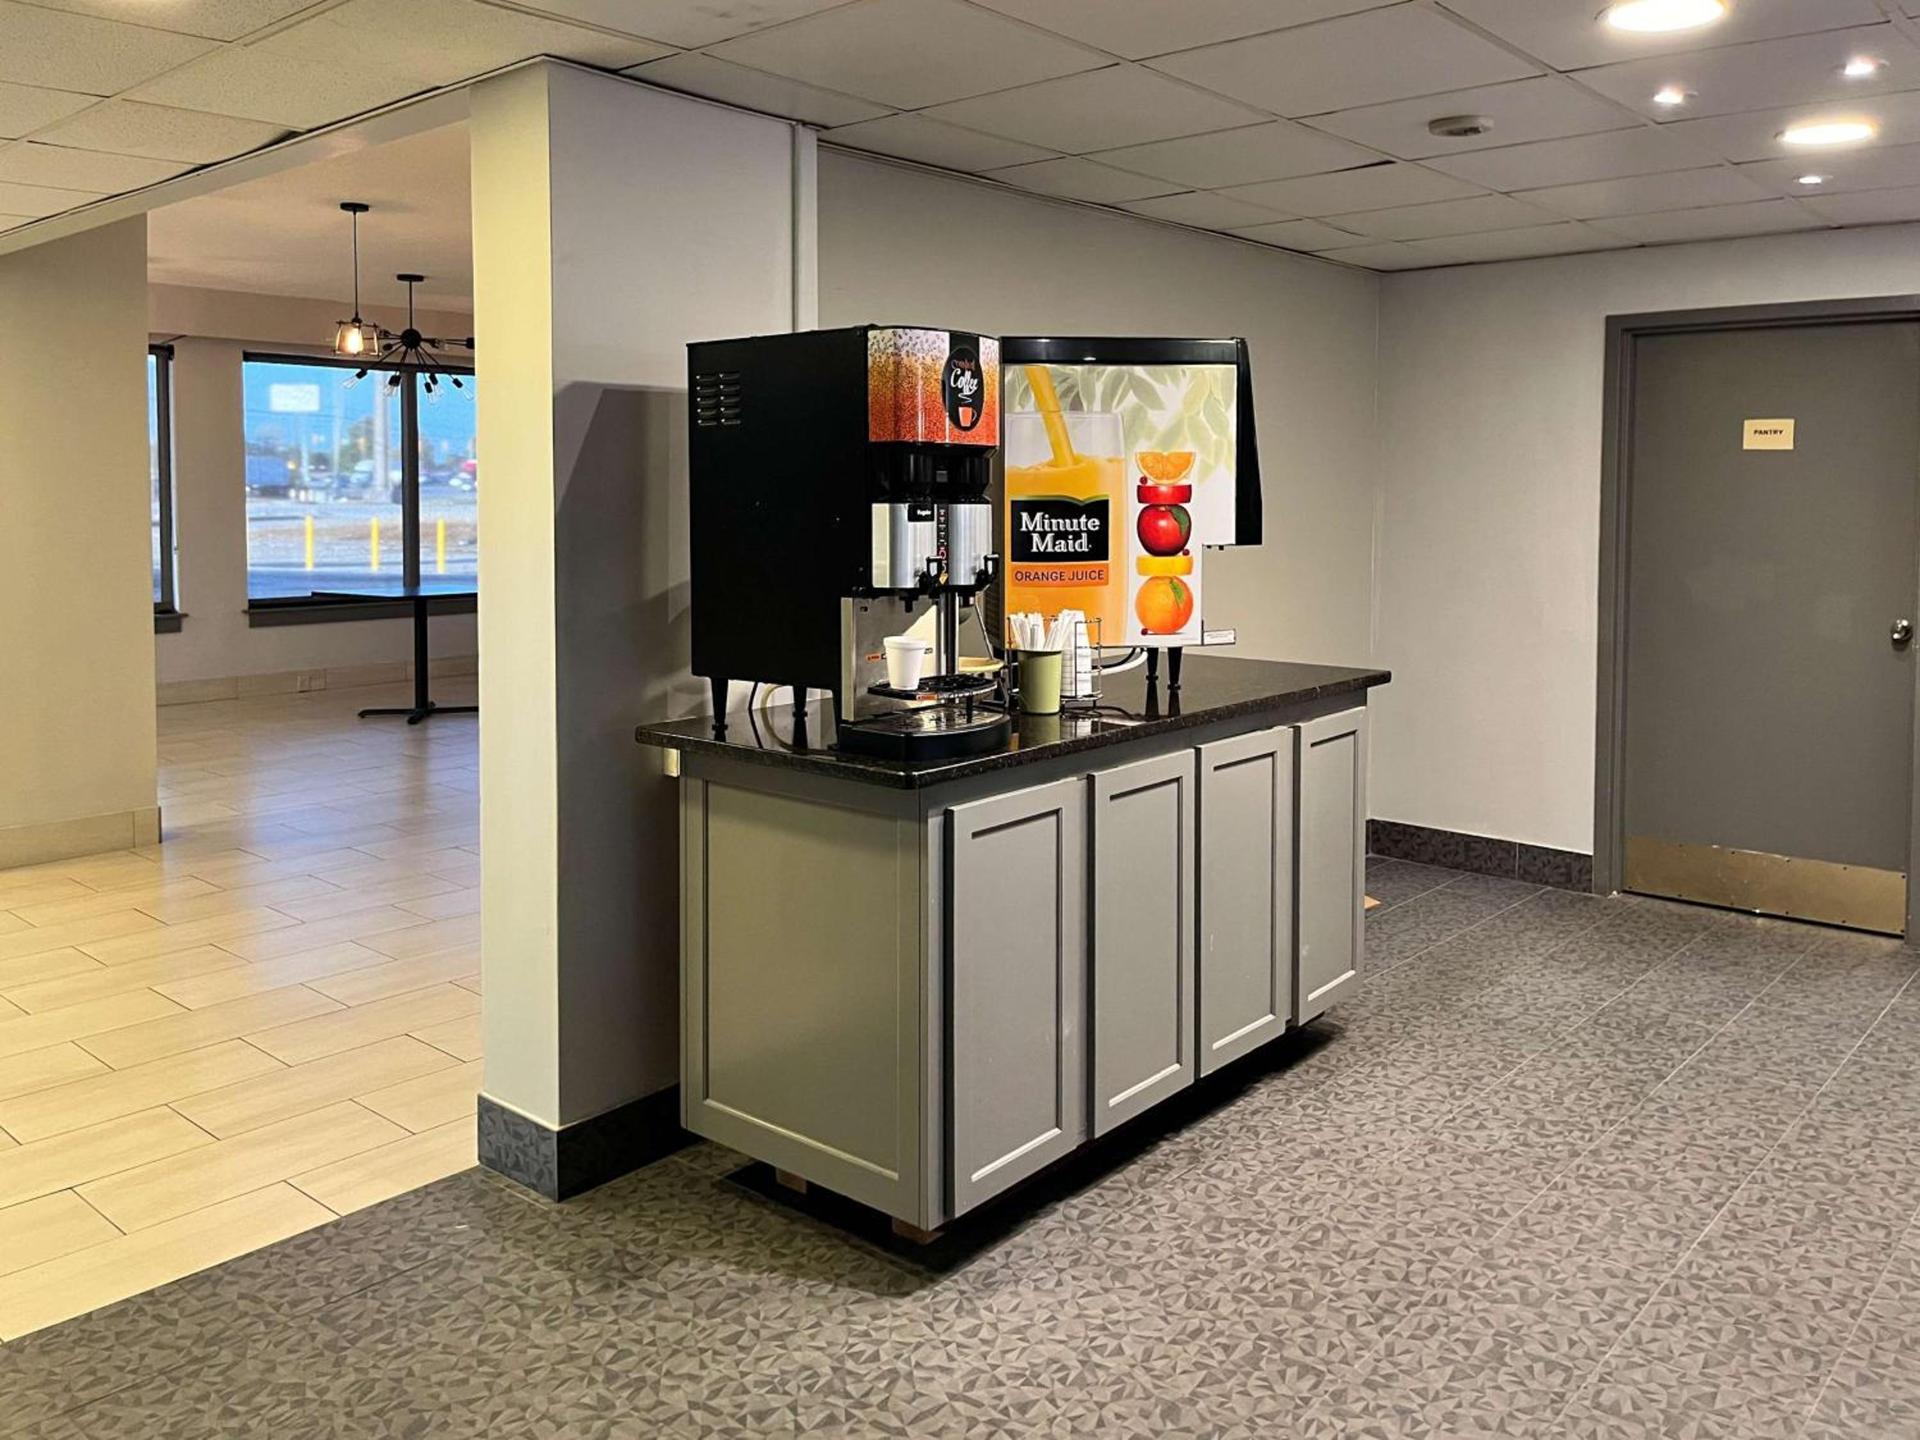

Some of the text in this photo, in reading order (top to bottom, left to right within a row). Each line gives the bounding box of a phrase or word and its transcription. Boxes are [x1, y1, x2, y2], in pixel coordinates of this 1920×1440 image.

[950, 368, 978, 395] Coffee
[1020, 511, 1100, 532] Minute
[1031, 532, 1090, 553] Maid
[1014, 569, 1105, 582] ORANGE JUICE
